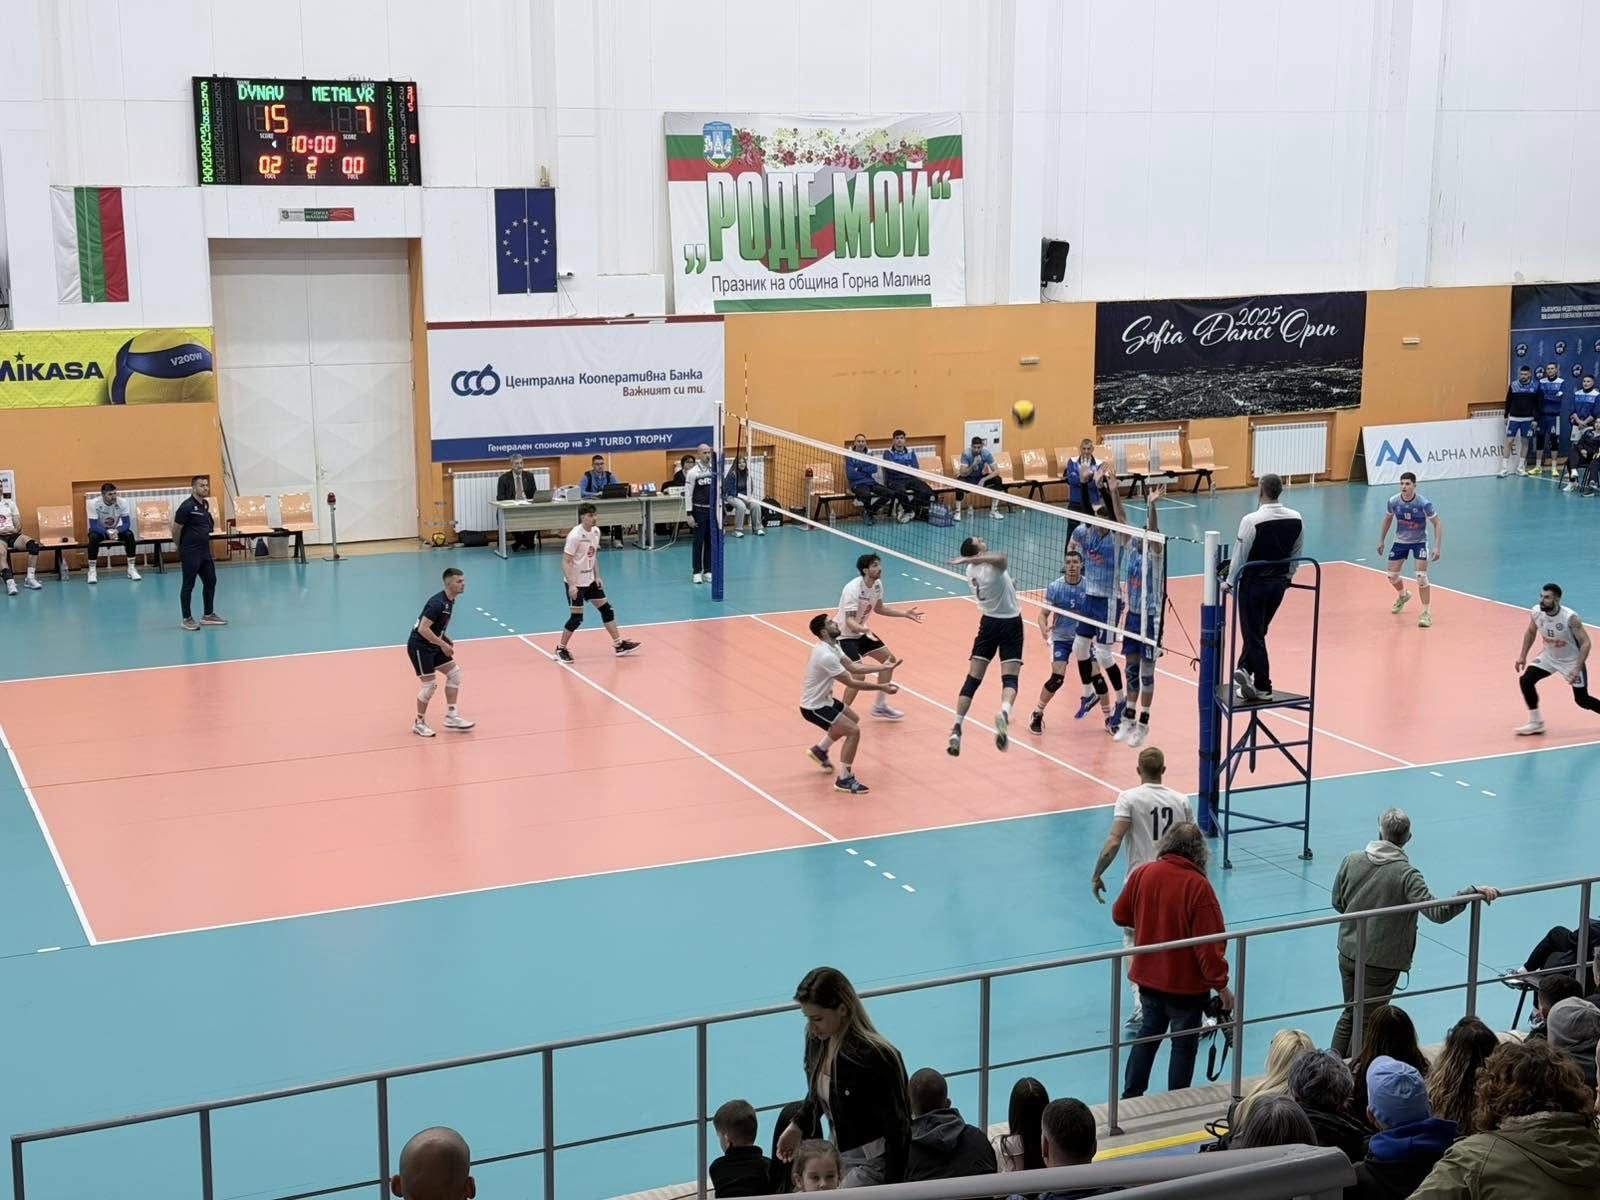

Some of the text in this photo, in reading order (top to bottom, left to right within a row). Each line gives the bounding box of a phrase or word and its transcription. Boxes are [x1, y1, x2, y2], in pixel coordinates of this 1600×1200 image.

[238, 85, 284, 100] DYNAV
[312, 86, 375, 102] METALYR
[264, 104, 289, 133] 15
[355, 105, 371, 133] 7
[291, 135, 336, 153] 10:00
[259, 155, 282, 174] 02
[306, 156, 318, 174] 2
[342, 156, 364, 174] 00
[711, 271, 931, 296] Празник на община Горна Малина
[1235, 305, 1283, 326] 2025
[1121, 308, 1339, 355] Sofia Dance Open
[170, 353, 202, 366] V200W
[505, 368, 703, 388] Централна Кооперативна Банка
[623, 386, 705, 397] Важният си ти.
[487, 443, 532, 453] Генерален
[534, 441, 569, 450] спонсор
[584, 437, 597, 447] 3rd
[599, 436, 631, 446] TURBO
[634, 434, 673, 444] TROPHY
[1427, 448, 1467, 462] ALPHA
[1150, 806, 1174, 841] 12
